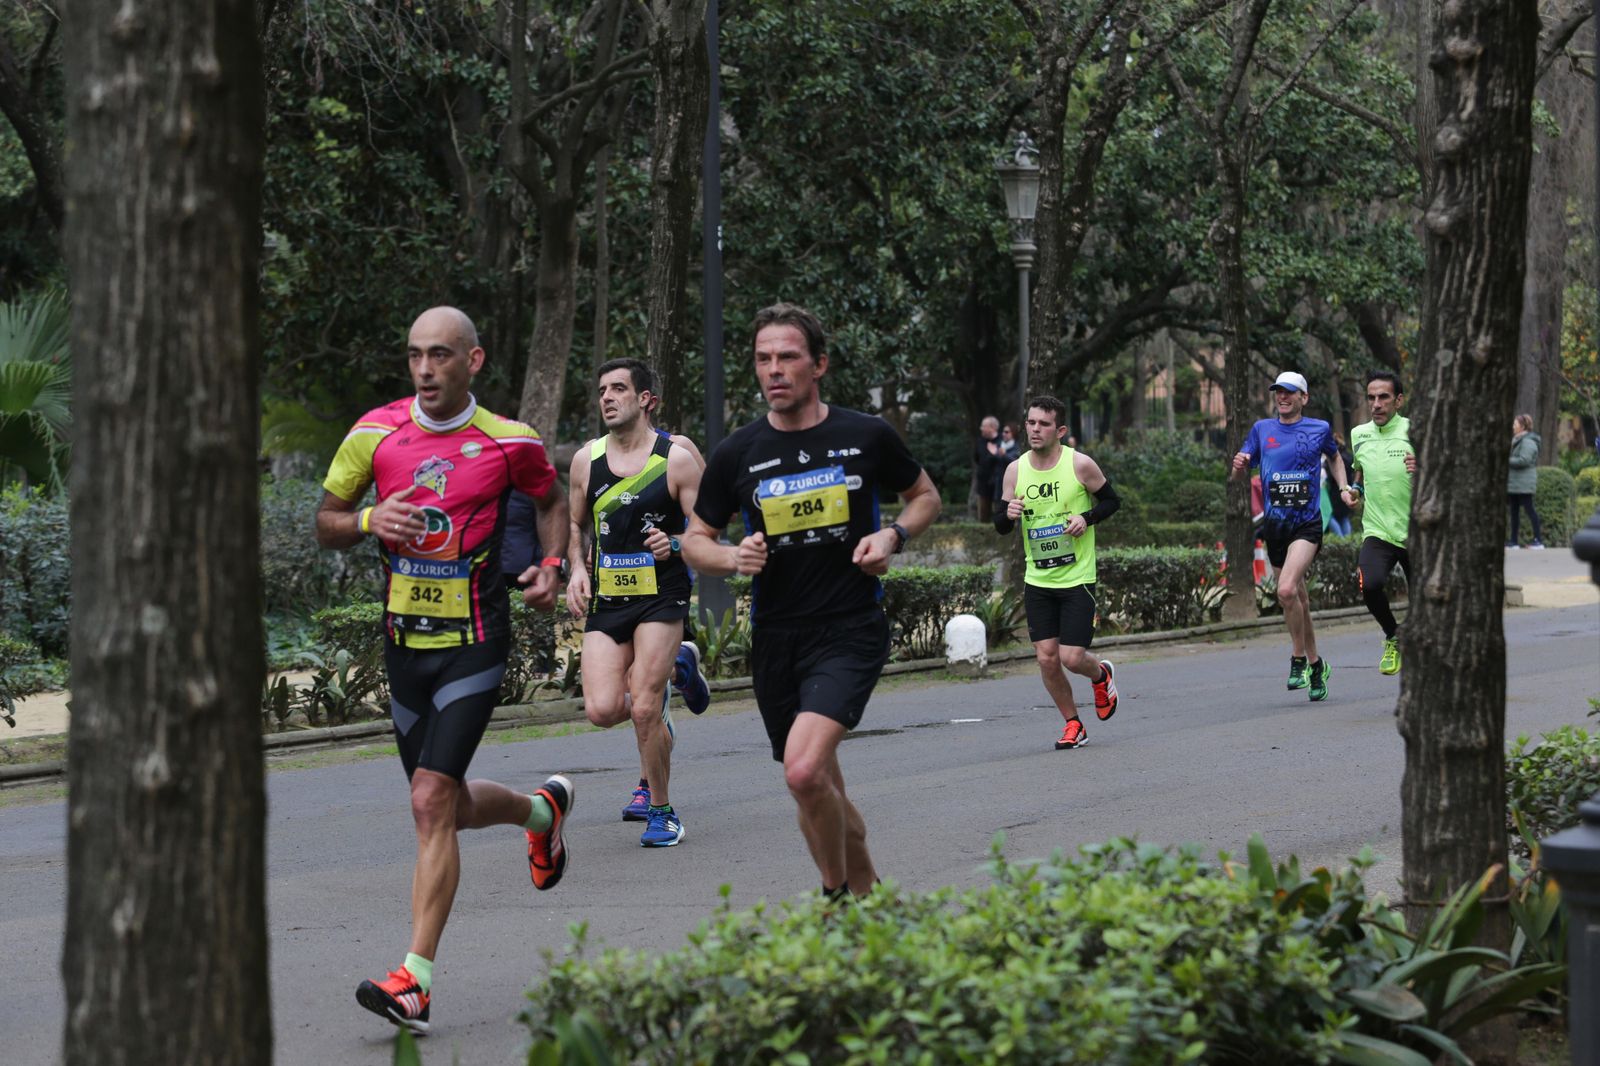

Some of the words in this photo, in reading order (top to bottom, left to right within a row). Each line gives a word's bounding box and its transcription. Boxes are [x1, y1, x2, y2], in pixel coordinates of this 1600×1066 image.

[788, 473, 835, 490] ZURICH
[1026, 481, 1060, 502] caf
[1278, 484, 1300, 493] 2771
[791, 498, 825, 518] 284
[1038, 526, 1064, 536] ZURICH
[1040, 541, 1058, 552] 660
[613, 557, 646, 566] ZURICH
[412, 563, 459, 576] ZURICH
[614, 574, 637, 586] 354
[410, 586, 443, 603] 342
